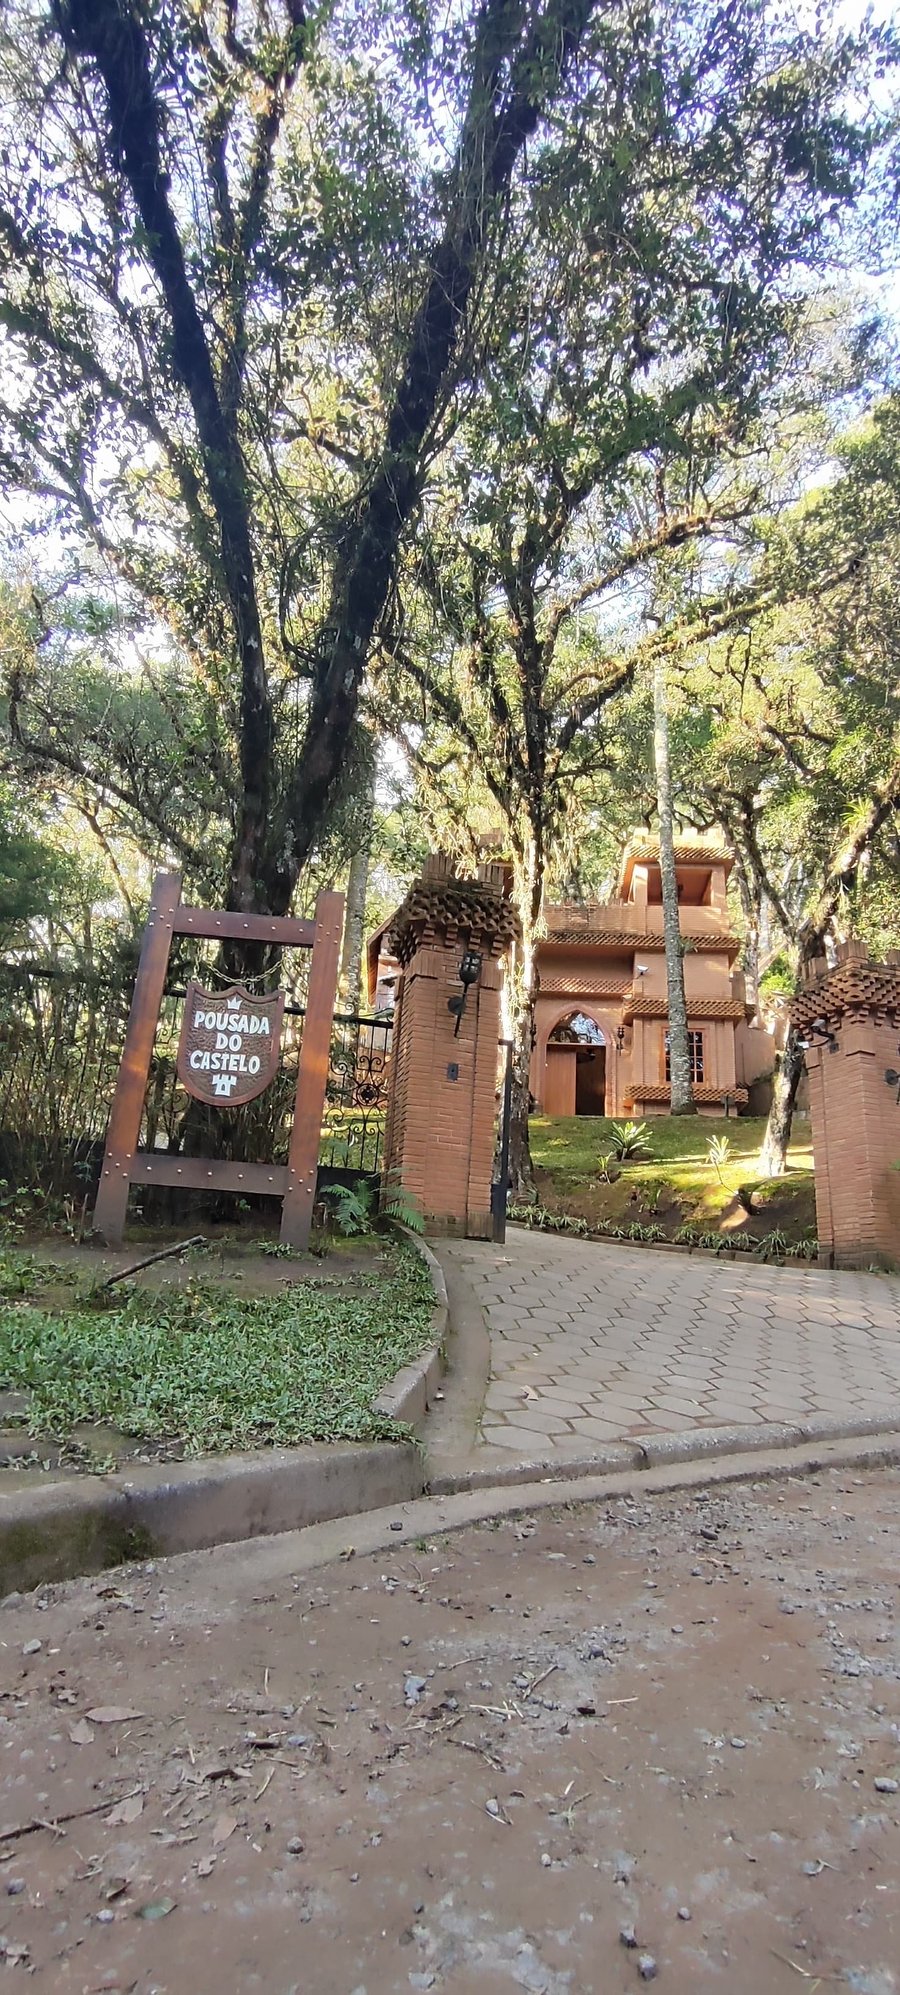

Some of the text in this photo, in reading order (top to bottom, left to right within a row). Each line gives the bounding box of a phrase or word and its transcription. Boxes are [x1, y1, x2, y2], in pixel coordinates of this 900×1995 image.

[194, 1010, 270, 1035] POUSADA
[215, 1033, 242, 1052] DO
[190, 1050, 261, 1074] CASTELO
